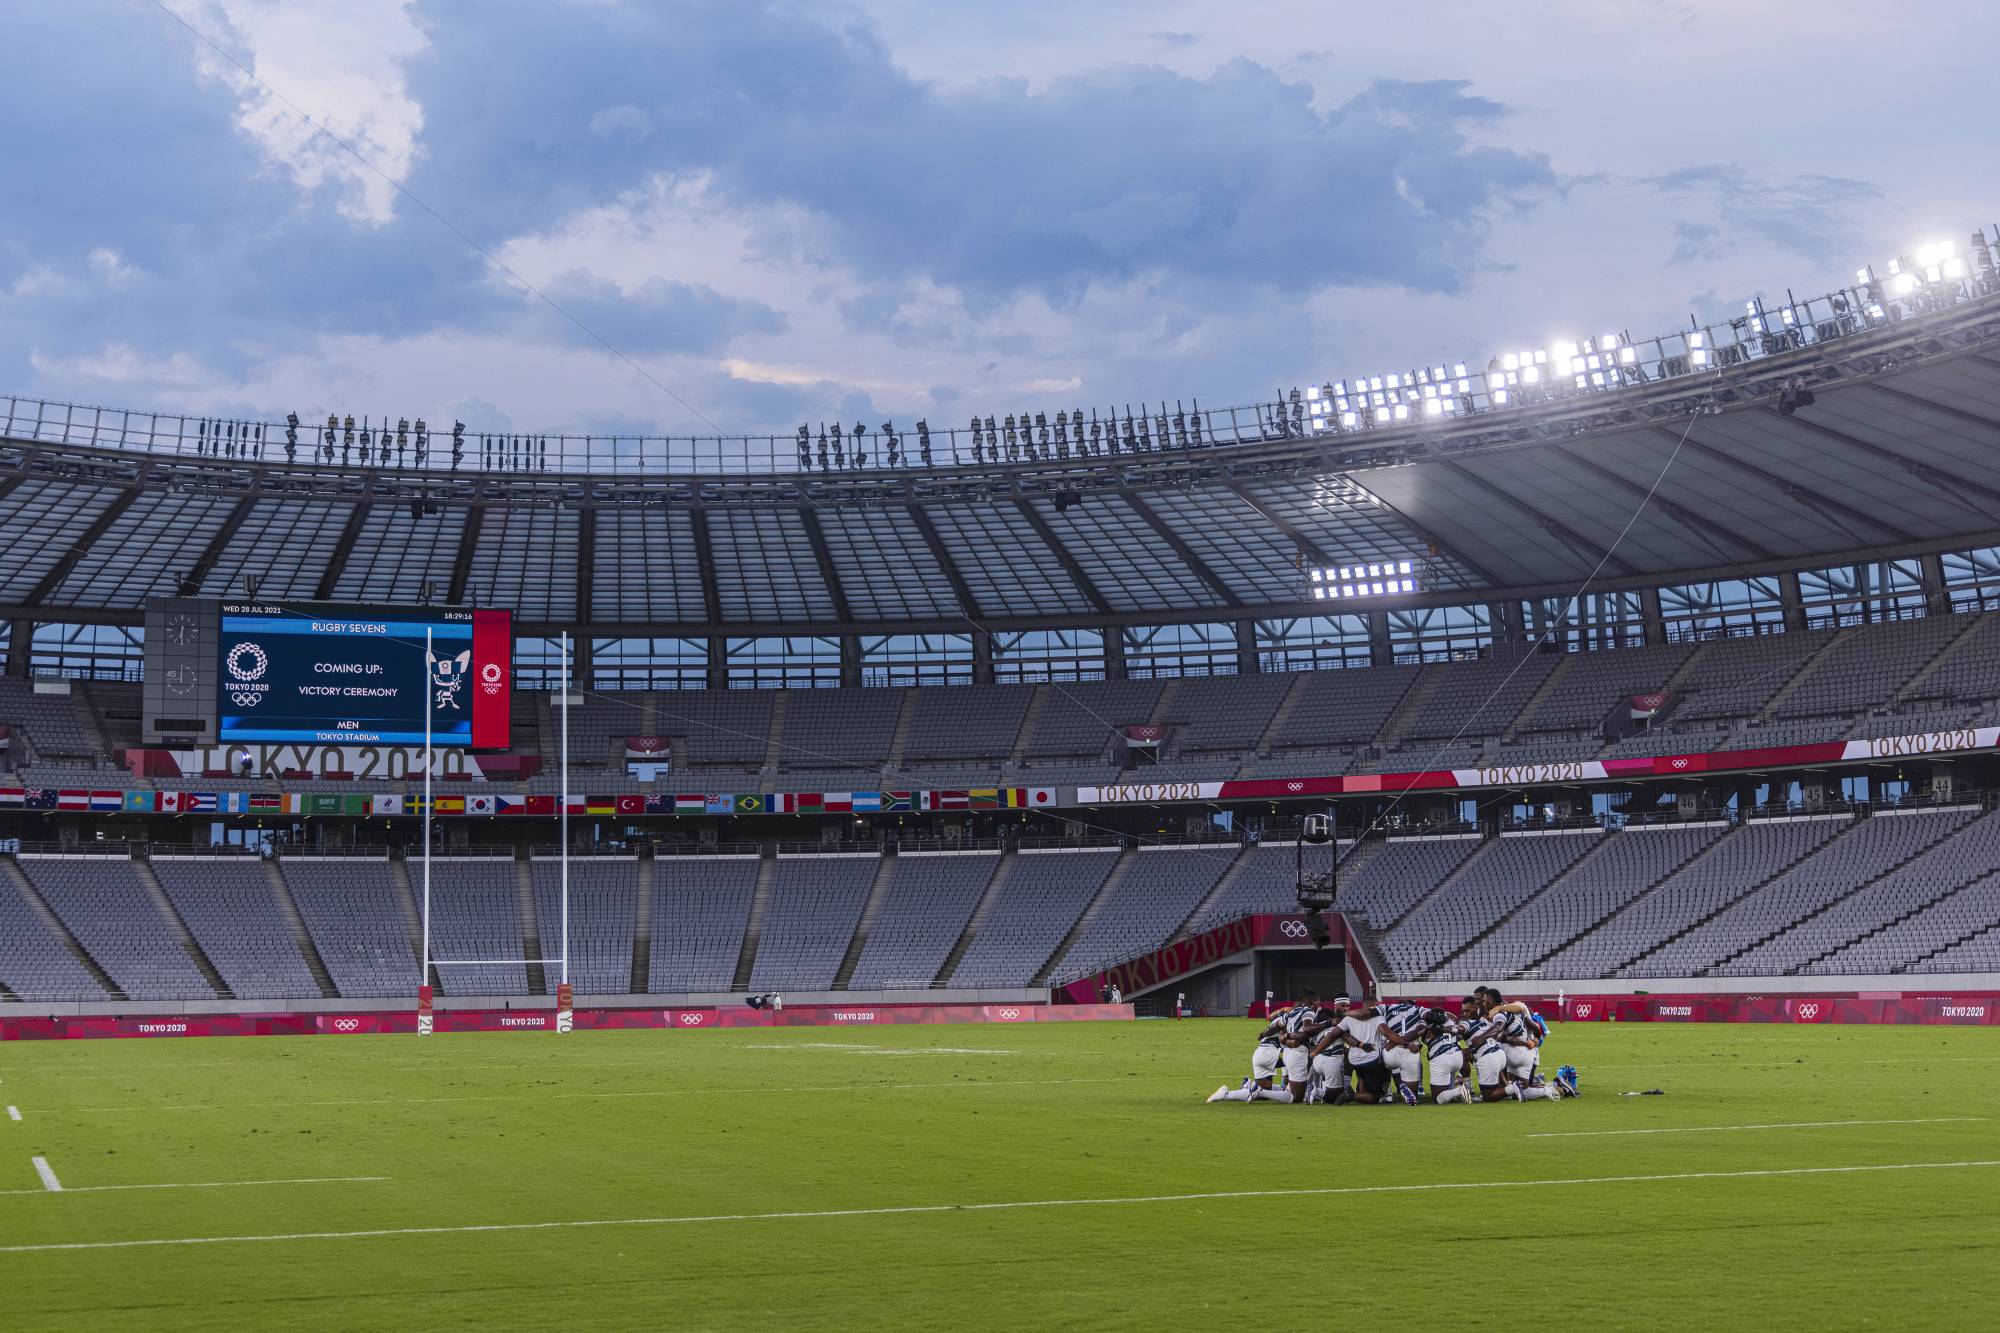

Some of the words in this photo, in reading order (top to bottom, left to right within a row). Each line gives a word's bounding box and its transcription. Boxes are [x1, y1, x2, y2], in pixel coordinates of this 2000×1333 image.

[265, 606, 281, 614] 2021
[312, 623, 347, 632] RUGBY
[349, 624, 387, 633] SEVENS
[314, 663, 363, 673] COMING
[365, 664, 383, 674] UP:
[224, 683, 250, 691] TOKYO
[250, 683, 269, 691] 2020
[299, 686, 341, 696] VICTORY
[343, 687, 398, 697] CEREMONY
[337, 721, 359, 729] MEN
[316, 733, 343, 741] TOKYO
[345, 733, 380, 741] STADIUM
[1867, 734, 1926, 757] TOKYO
[1932, 728, 1976, 752] 2020
[1477, 766, 1536, 786] TOKYO
[1540, 764, 1582, 783] 2020
[1935, 779, 1948, 791] 44
[1095, 784, 1153, 802] TOKYO
[1158, 783, 1200, 801] 2020
[1807, 789, 1820, 801] 45
[1680, 797, 1693, 809] 46
[1184, 920, 1250, 968] 2020
[1659, 1006, 1678, 1016] TOKYO
[1677, 1006, 1692, 1016] 2020
[1942, 1006, 1965, 1017] TOKYO
[1966, 1006, 1985, 1016] 2020
[501, 1018, 526, 1026] TOKYO
[138, 1024, 166, 1032] TOKYO
[166, 1024, 187, 1032] 2020
